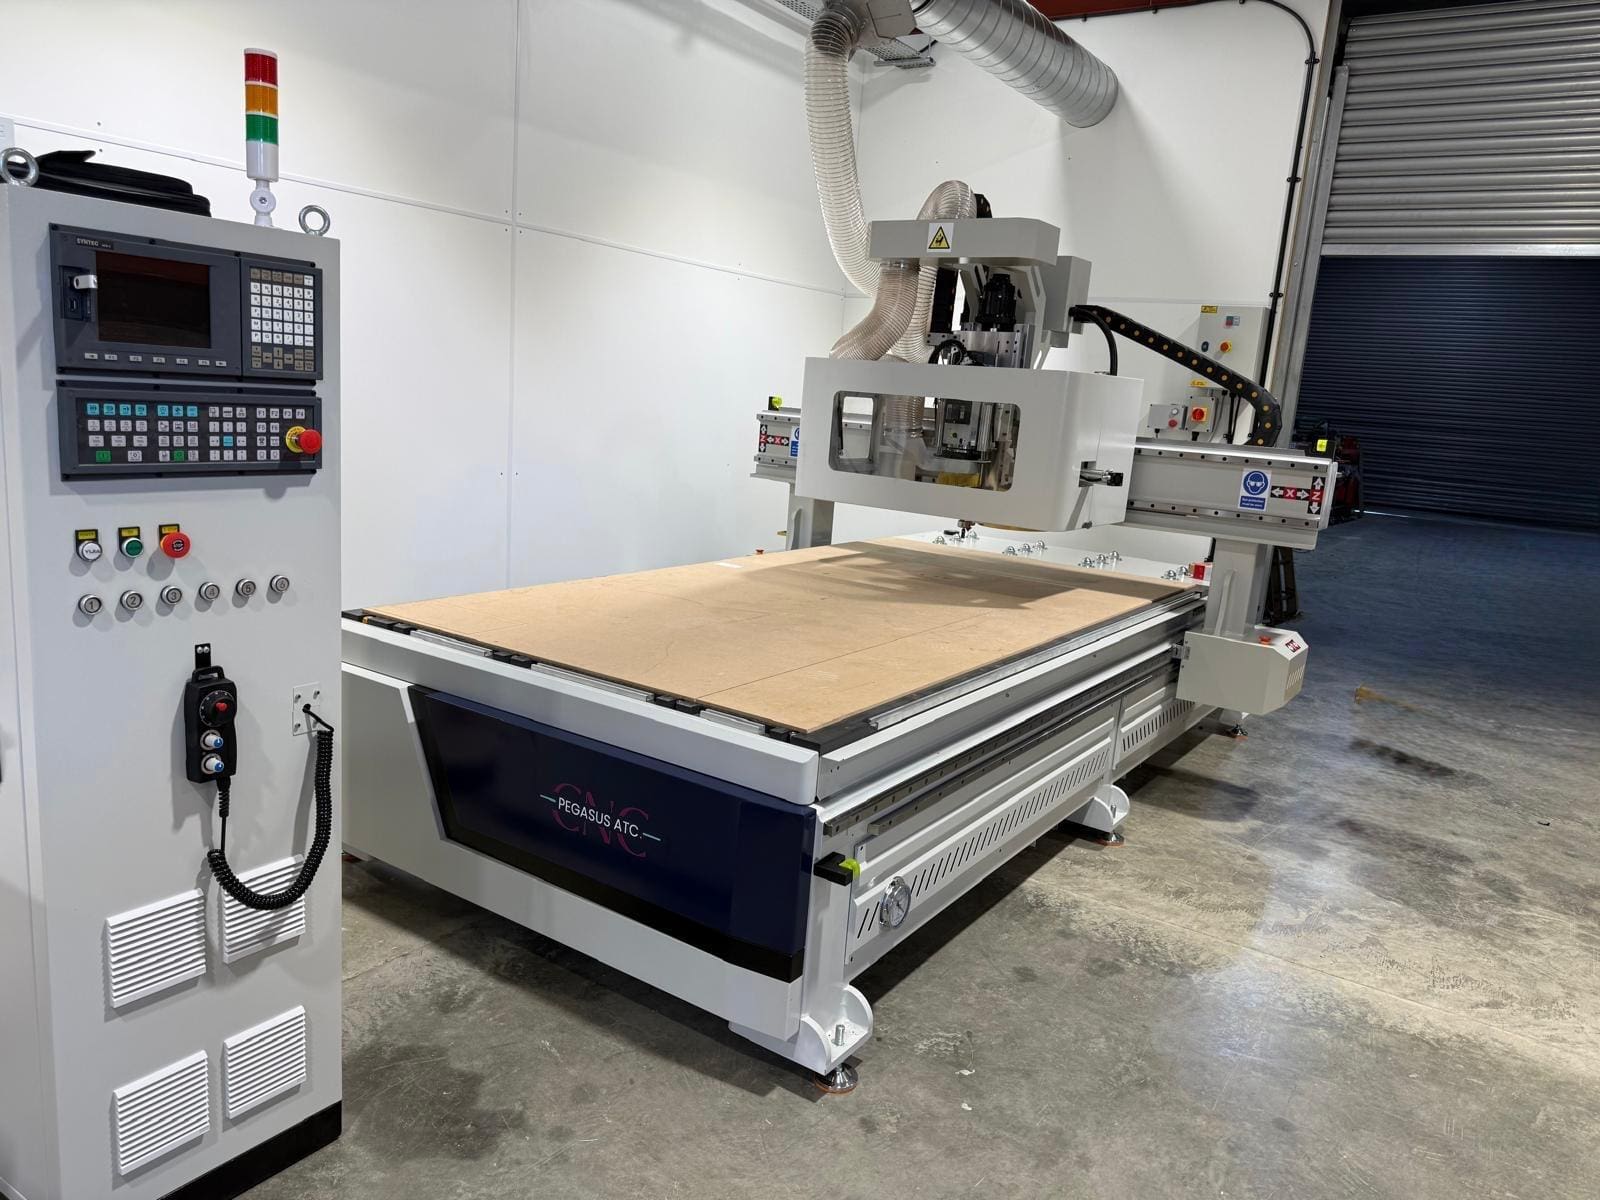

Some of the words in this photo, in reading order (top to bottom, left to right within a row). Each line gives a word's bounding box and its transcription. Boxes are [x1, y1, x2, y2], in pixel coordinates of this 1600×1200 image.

[1286, 489, 1294, 498] X
[1312, 492, 1320, 500] Z
[171, 591, 177, 600] 3
[130, 596, 137, 605] 2
[89, 601, 94, 610] 1
[557, 796, 611, 828] PEGASUS
